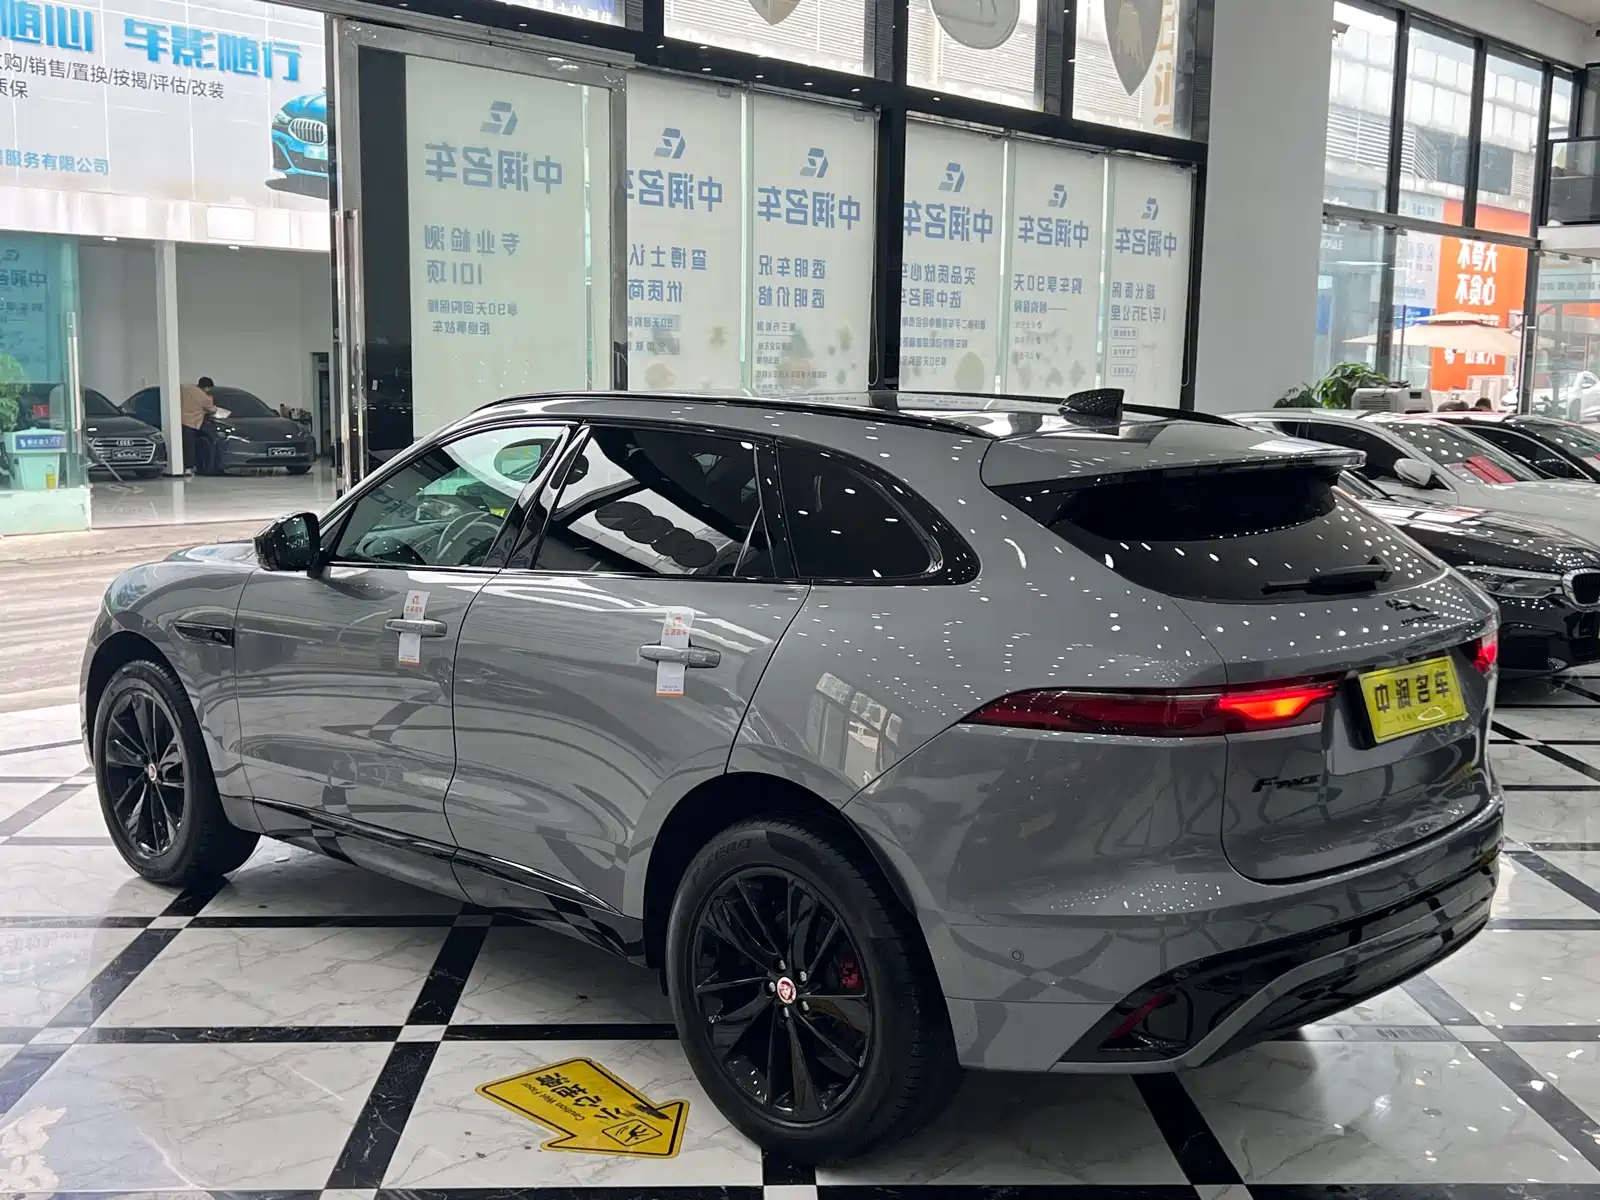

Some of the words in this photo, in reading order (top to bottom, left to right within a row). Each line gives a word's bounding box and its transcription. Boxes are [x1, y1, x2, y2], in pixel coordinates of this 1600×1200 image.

[123, 18, 302, 83] 车影随行
[0, 52, 225, 100] 购/销售/置换/按揭/评估/改装
[0, 150, 109, 176] 服务有限公司
[1374, 669, 1450, 713] 中润名车
